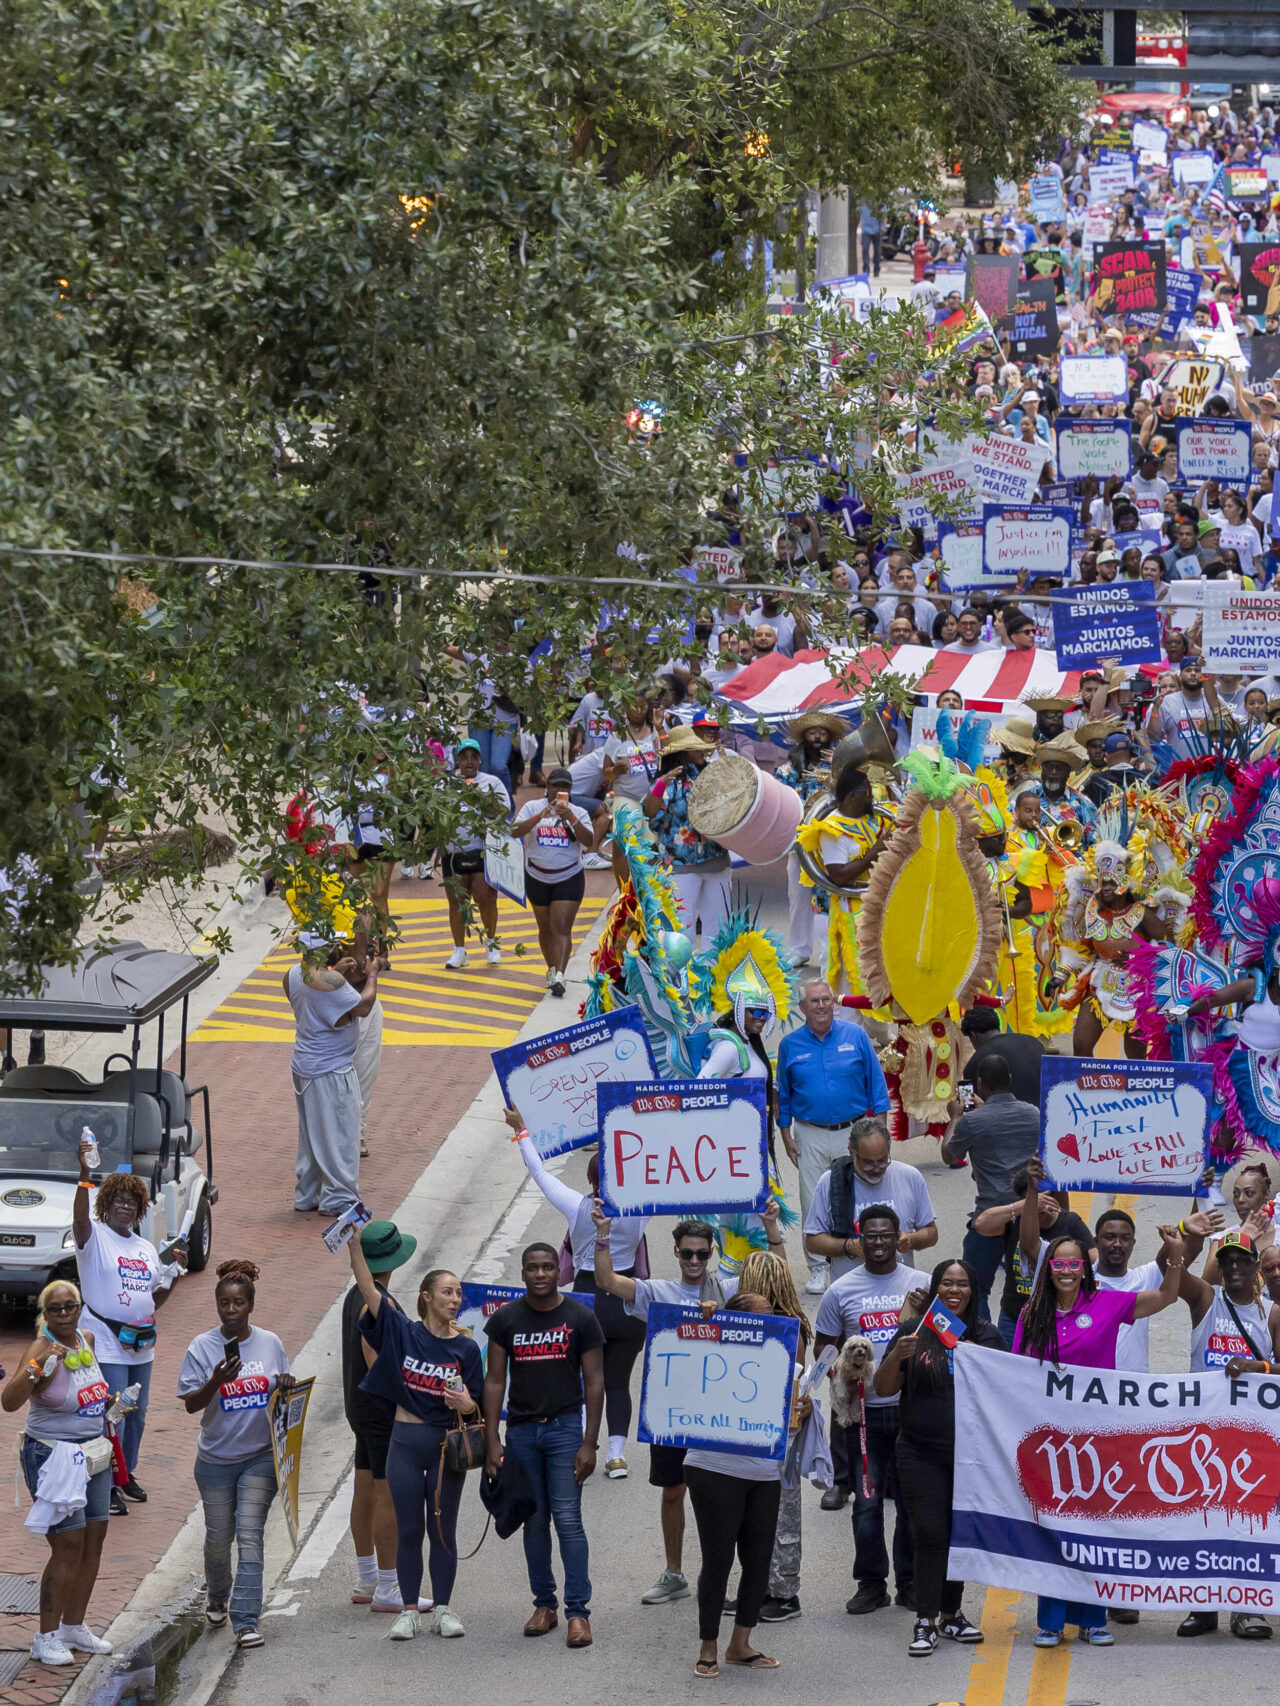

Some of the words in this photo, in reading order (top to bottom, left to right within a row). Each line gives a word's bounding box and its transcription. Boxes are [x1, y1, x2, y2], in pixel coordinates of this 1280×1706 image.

[1101, 251, 1150, 276] SCAN
[1115, 272, 1156, 292] PROTECT
[1124, 270, 1135, 278] TO
[1166, 272, 1190, 283] NITED
[1115, 287, 1157, 313] 340B
[1015, 314, 1037, 327] NOT
[985, 437, 1027, 457] UNITED
[1186, 436, 1203, 446] OUR
[1208, 437, 1232, 446] VOICE
[971, 444, 989, 457] WE
[993, 451, 1033, 472] STAND.
[910, 469, 955, 487] UNITED
[973, 463, 1027, 488] OGETHER
[982, 478, 1027, 501] MARCH.
[907, 515, 928, 528] WE
[1076, 588, 1130, 602] UNIDOS
[1229, 597, 1280, 610] UNIDOS
[1070, 600, 1139, 617] ESTAMOS.
[1079, 625, 1135, 642] JUNTOS
[1062, 636, 1155, 656] MARCHAMOS.
[538, 837, 570, 848] PEOPLE
[526, 1037, 552, 1051] MARCH
[555, 1031, 571, 1042] FOR
[572, 1019, 607, 1037] FREEDOM
[530, 1050, 547, 1067] We
[546, 1044, 567, 1064] The
[570, 1028, 612, 1053] PEOPLE
[529, 1062, 610, 1102] SPEND
[688, 1083, 727, 1091] FREEDOM
[1081, 1075, 1098, 1089] We
[1099, 1074, 1122, 1088] The
[1127, 1078, 1175, 1089] PEOPLE
[636, 1096, 655, 1112] We
[655, 1095, 678, 1111] The
[682, 1094, 729, 1109] PEOPLE
[1118, 1159, 1156, 1176] WE
[1160, 1151, 1205, 1170] NEED
[2, 1235, 19, 1245] Club
[19, 1236, 33, 1246] Car
[121, 1268, 151, 1279] PEOPLE
[121, 1281, 150, 1293] MARCH
[486, 1288, 512, 1299] MARCH
[862, 1294, 904, 1306] MARCH
[862, 1313, 880, 1328] We
[512, 1330, 565, 1347] ELIJAH
[681, 1324, 697, 1338] We
[697, 1324, 717, 1338] The
[721, 1329, 764, 1343] PEOPLE
[512, 1343, 570, 1357] MANLEY
[1212, 1335, 1228, 1351] We
[1228, 1336, 1249, 1353] The
[403, 1355, 457, 1379] ELIJAH
[223, 1380, 244, 1397] We
[243, 1377, 267, 1394] The
[1046, 1368, 1203, 1411] MARCH
[81, 1390, 95, 1405] We
[223, 1391, 269, 1412] PEOPLE
[1034, 1431, 1138, 1515] We
[1139, 1424, 1268, 1508] The
[1060, 1540, 1152, 1569] UNITED
[1157, 1555, 1191, 1573] we
[1195, 1549, 1266, 1575] Stand.
[1094, 1578, 1274, 1608] WTPMARCH.ORG
